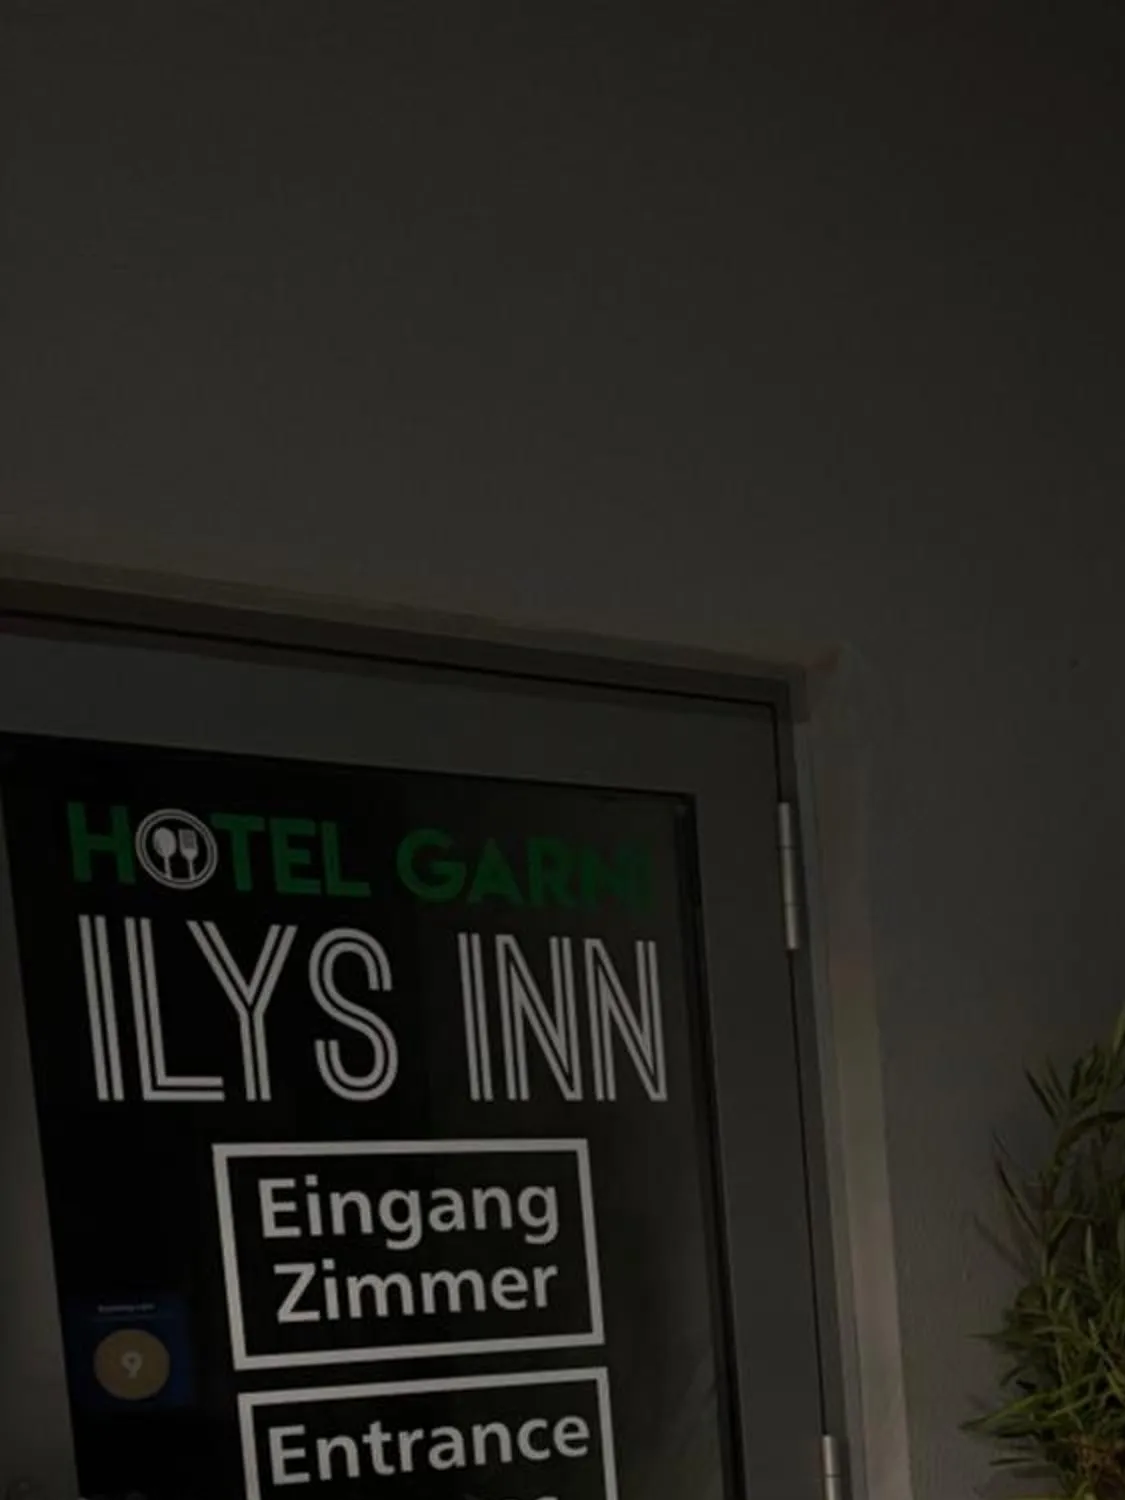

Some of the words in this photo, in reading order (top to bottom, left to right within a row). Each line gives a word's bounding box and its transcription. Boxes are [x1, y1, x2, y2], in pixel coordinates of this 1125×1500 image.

[394, 827, 656, 912] GARNI
[78, 913, 399, 1102] ILYS
[457, 931, 668, 1101] INN
[257, 1175, 560, 1250] Eingang
[272, 1258, 560, 1324] Zimmer
[267, 1413, 591, 1487] Entrance
